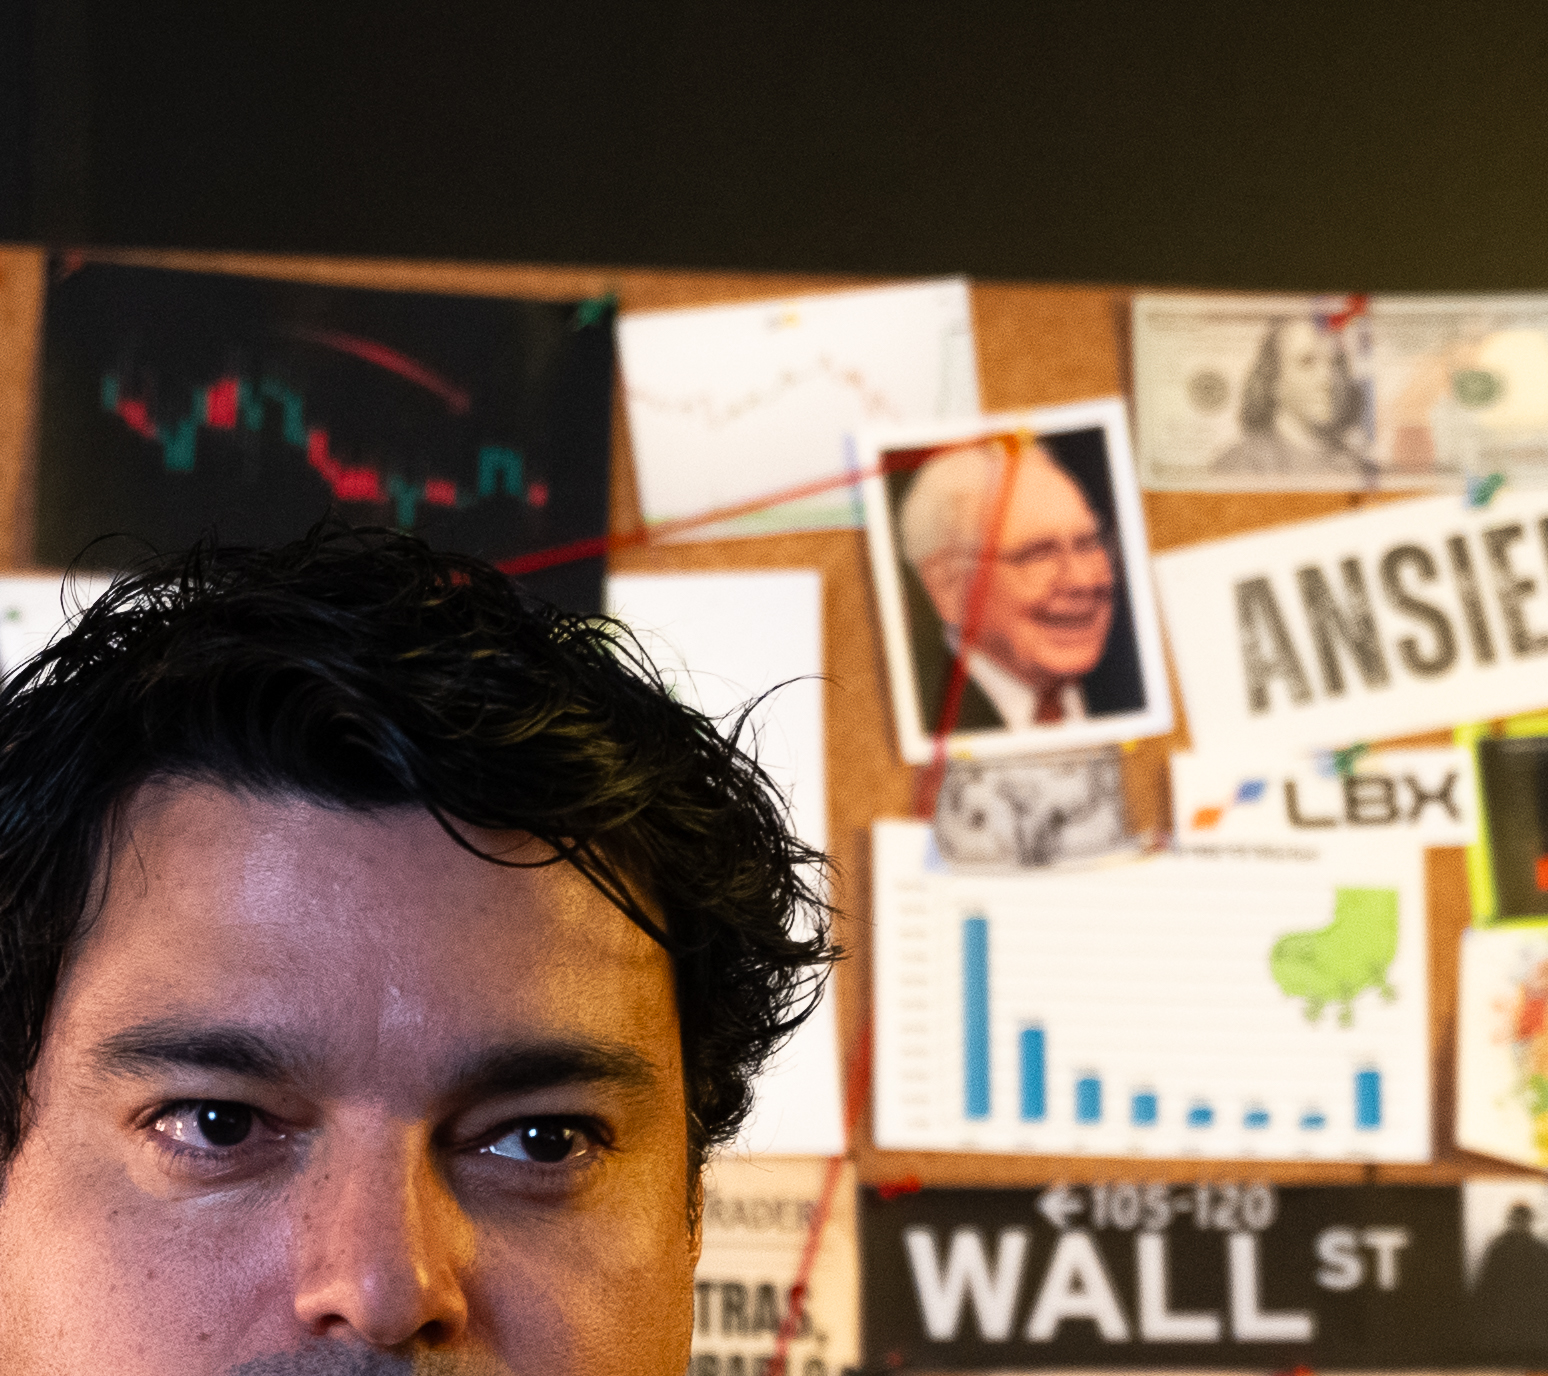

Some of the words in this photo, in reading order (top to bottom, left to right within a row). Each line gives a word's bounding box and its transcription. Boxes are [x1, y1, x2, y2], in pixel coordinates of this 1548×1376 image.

[1284, 768, 1463, 830] LBX
[1091, 1178, 1276, 1233] 105-120
[902, 1228, 1318, 1344] WALL
[1313, 1226, 1412, 1293] ST
